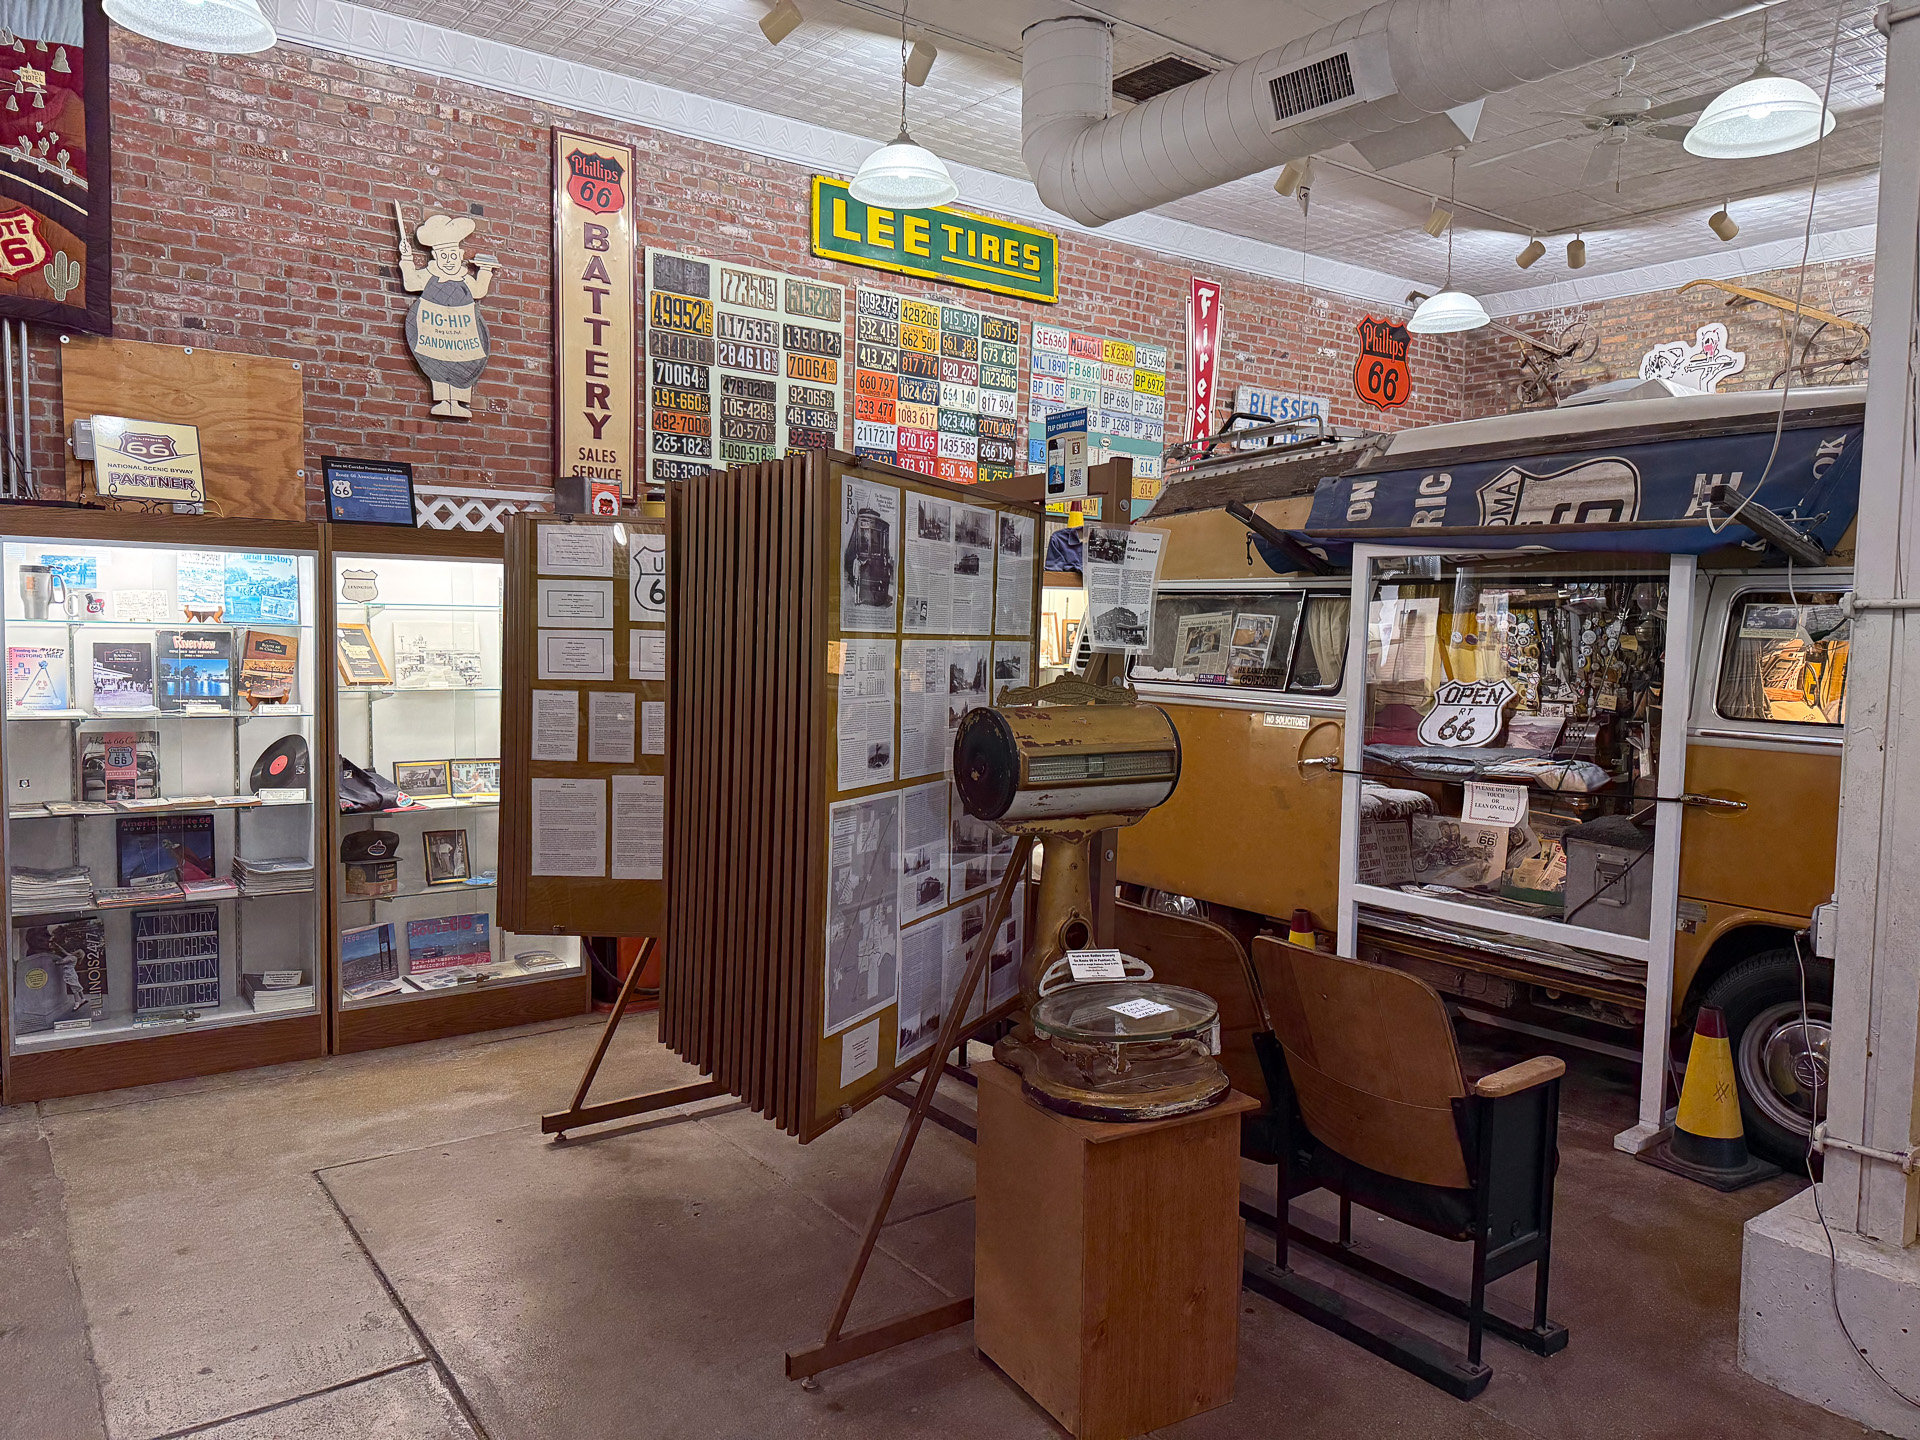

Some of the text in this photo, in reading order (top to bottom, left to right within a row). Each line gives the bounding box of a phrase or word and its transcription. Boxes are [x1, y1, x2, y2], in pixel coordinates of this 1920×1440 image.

[22, 75, 44, 84] MOTEL
[571, 154, 620, 182] Phillips
[579, 181, 612, 208] 66
[832, 197, 1041, 272] LEE TIRES
[422, 309, 471, 328] PIG-HIP
[653, 294, 702, 333] 49952
[581, 221, 612, 440] BATTERY
[720, 315, 771, 343] 117535
[419, 334, 480, 351] SANDWICHES
[786, 327, 833, 354] 135812
[1364, 322, 1404, 364] Phillips
[720, 343, 770, 371] 284618
[1033, 355, 1066, 373] NL 1890
[656, 361, 699, 388] 70064
[790, 356, 827, 379] 70064
[1068, 361, 1101, 380] FB 6810
[1102, 368, 1133, 386] UB 4652
[1135, 374, 1164, 392] BP 6972
[1368, 360, 1398, 401] 66
[1032, 380, 1065, 397] BP 1185
[1070, 386, 1097, 403] BP 797
[1103, 391, 1130, 409] BP 686
[1145, 400, 1163, 415] 1268
[1250, 393, 1319, 423] BLESSED
[1056, 421, 1069, 431] CHART
[1069, 418, 1086, 428] LIBRARY
[1101, 415, 1130, 432] BP 1268
[1134, 421, 1162, 438] BP 1270
[857, 426, 895, 445] 2117217
[126, 441, 170, 457] 66
[578, 447, 617, 464] SALES
[107, 463, 142, 471] NATIONAL
[571, 464, 623, 480] SERVICE
[1140, 461, 1152, 474] 614
[108, 472, 196, 491] PARTNER
[1140, 484, 1152, 496] 614
[335, 486, 350, 496] 66
[1346, 480, 1378, 522] ON
[172, 635, 216, 650] Riverview
[1255, 677, 1278, 687] HOME
[1444, 686, 1504, 705] OPEN
[1266, 714, 1308, 727] NO SOLICITORS
[1458, 707, 1474, 716] RT
[1437, 715, 1476, 742] 66
[113, 737, 125, 745] 66
[114, 757, 127, 765] 66
[1475, 785, 1496, 793] PLEASE
[121, 816, 212, 828] American Route 66
[1479, 836, 1496, 846] 66
[137, 912, 217, 937] A CENTURY
[411, 916, 473, 937] ROUTE 66
[136, 935, 218, 961] OF PROGRESS
[137, 959, 218, 985] EXPOSITION
[136, 982, 219, 1009] CHICAGO 1933
